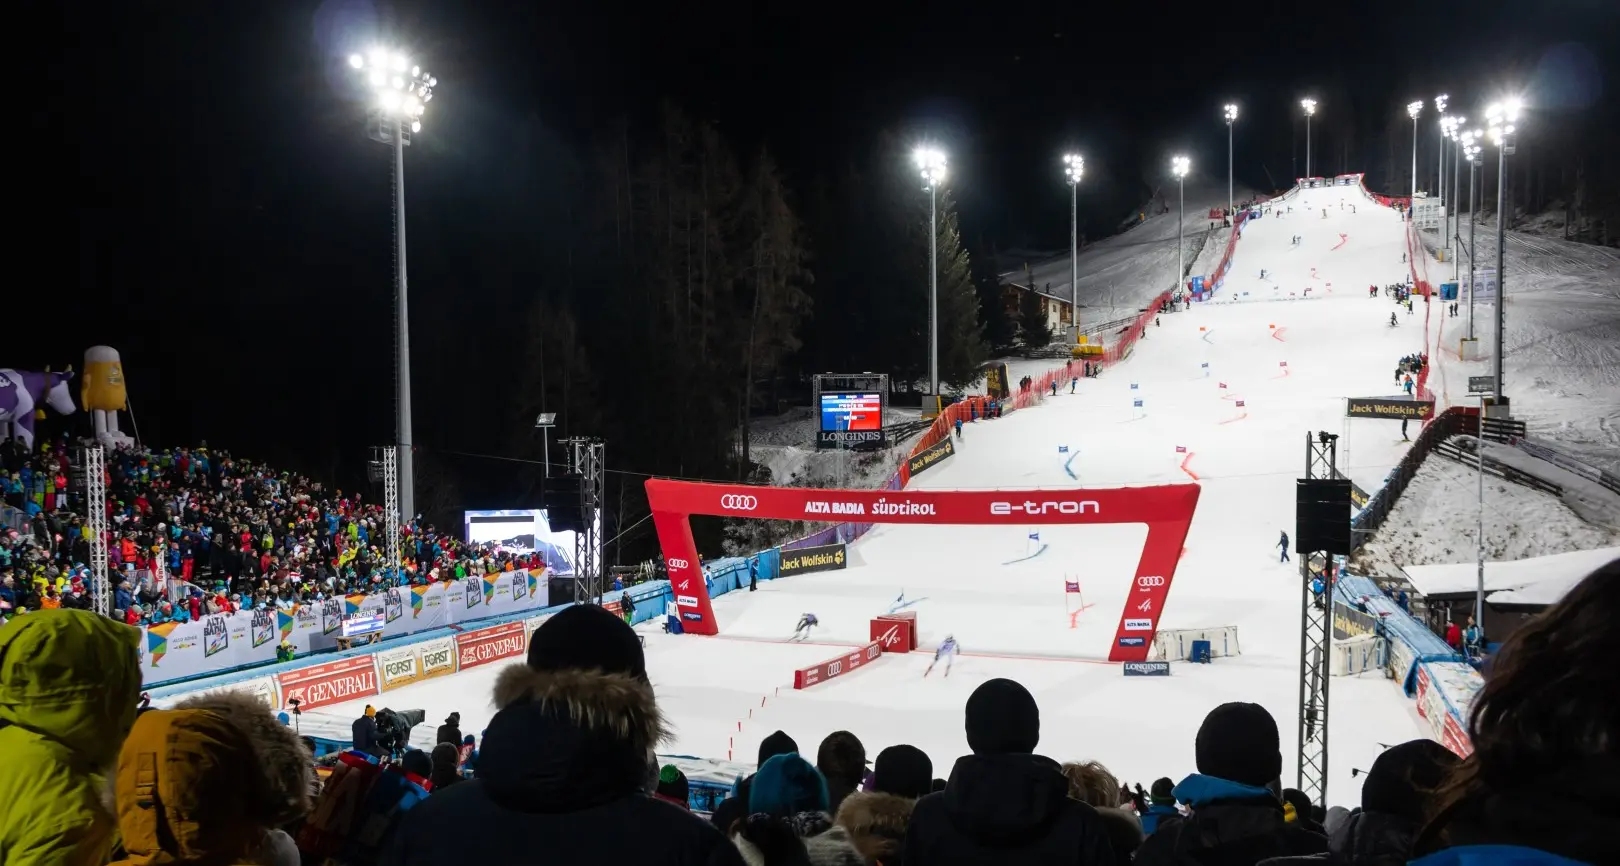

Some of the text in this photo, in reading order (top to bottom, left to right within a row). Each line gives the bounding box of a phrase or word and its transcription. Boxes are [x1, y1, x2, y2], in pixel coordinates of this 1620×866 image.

[1351, 404, 1415, 414] Jack Wolfskin
[822, 432, 881, 441] LONGINES
[805, 501, 831, 514] ALTA
[832, 502, 865, 515] BADIA
[990, 500, 1100, 515] e-tron
[780, 553, 833, 570] Jack Wolfskin
[204, 624, 228, 637] BADIA
[206, 617, 225, 629] ALTA
[476, 635, 524, 661] GENERALI
[424, 650, 449, 667] FORST
[385, 658, 413, 676] FORST
[307, 671, 376, 704] GENERALI
